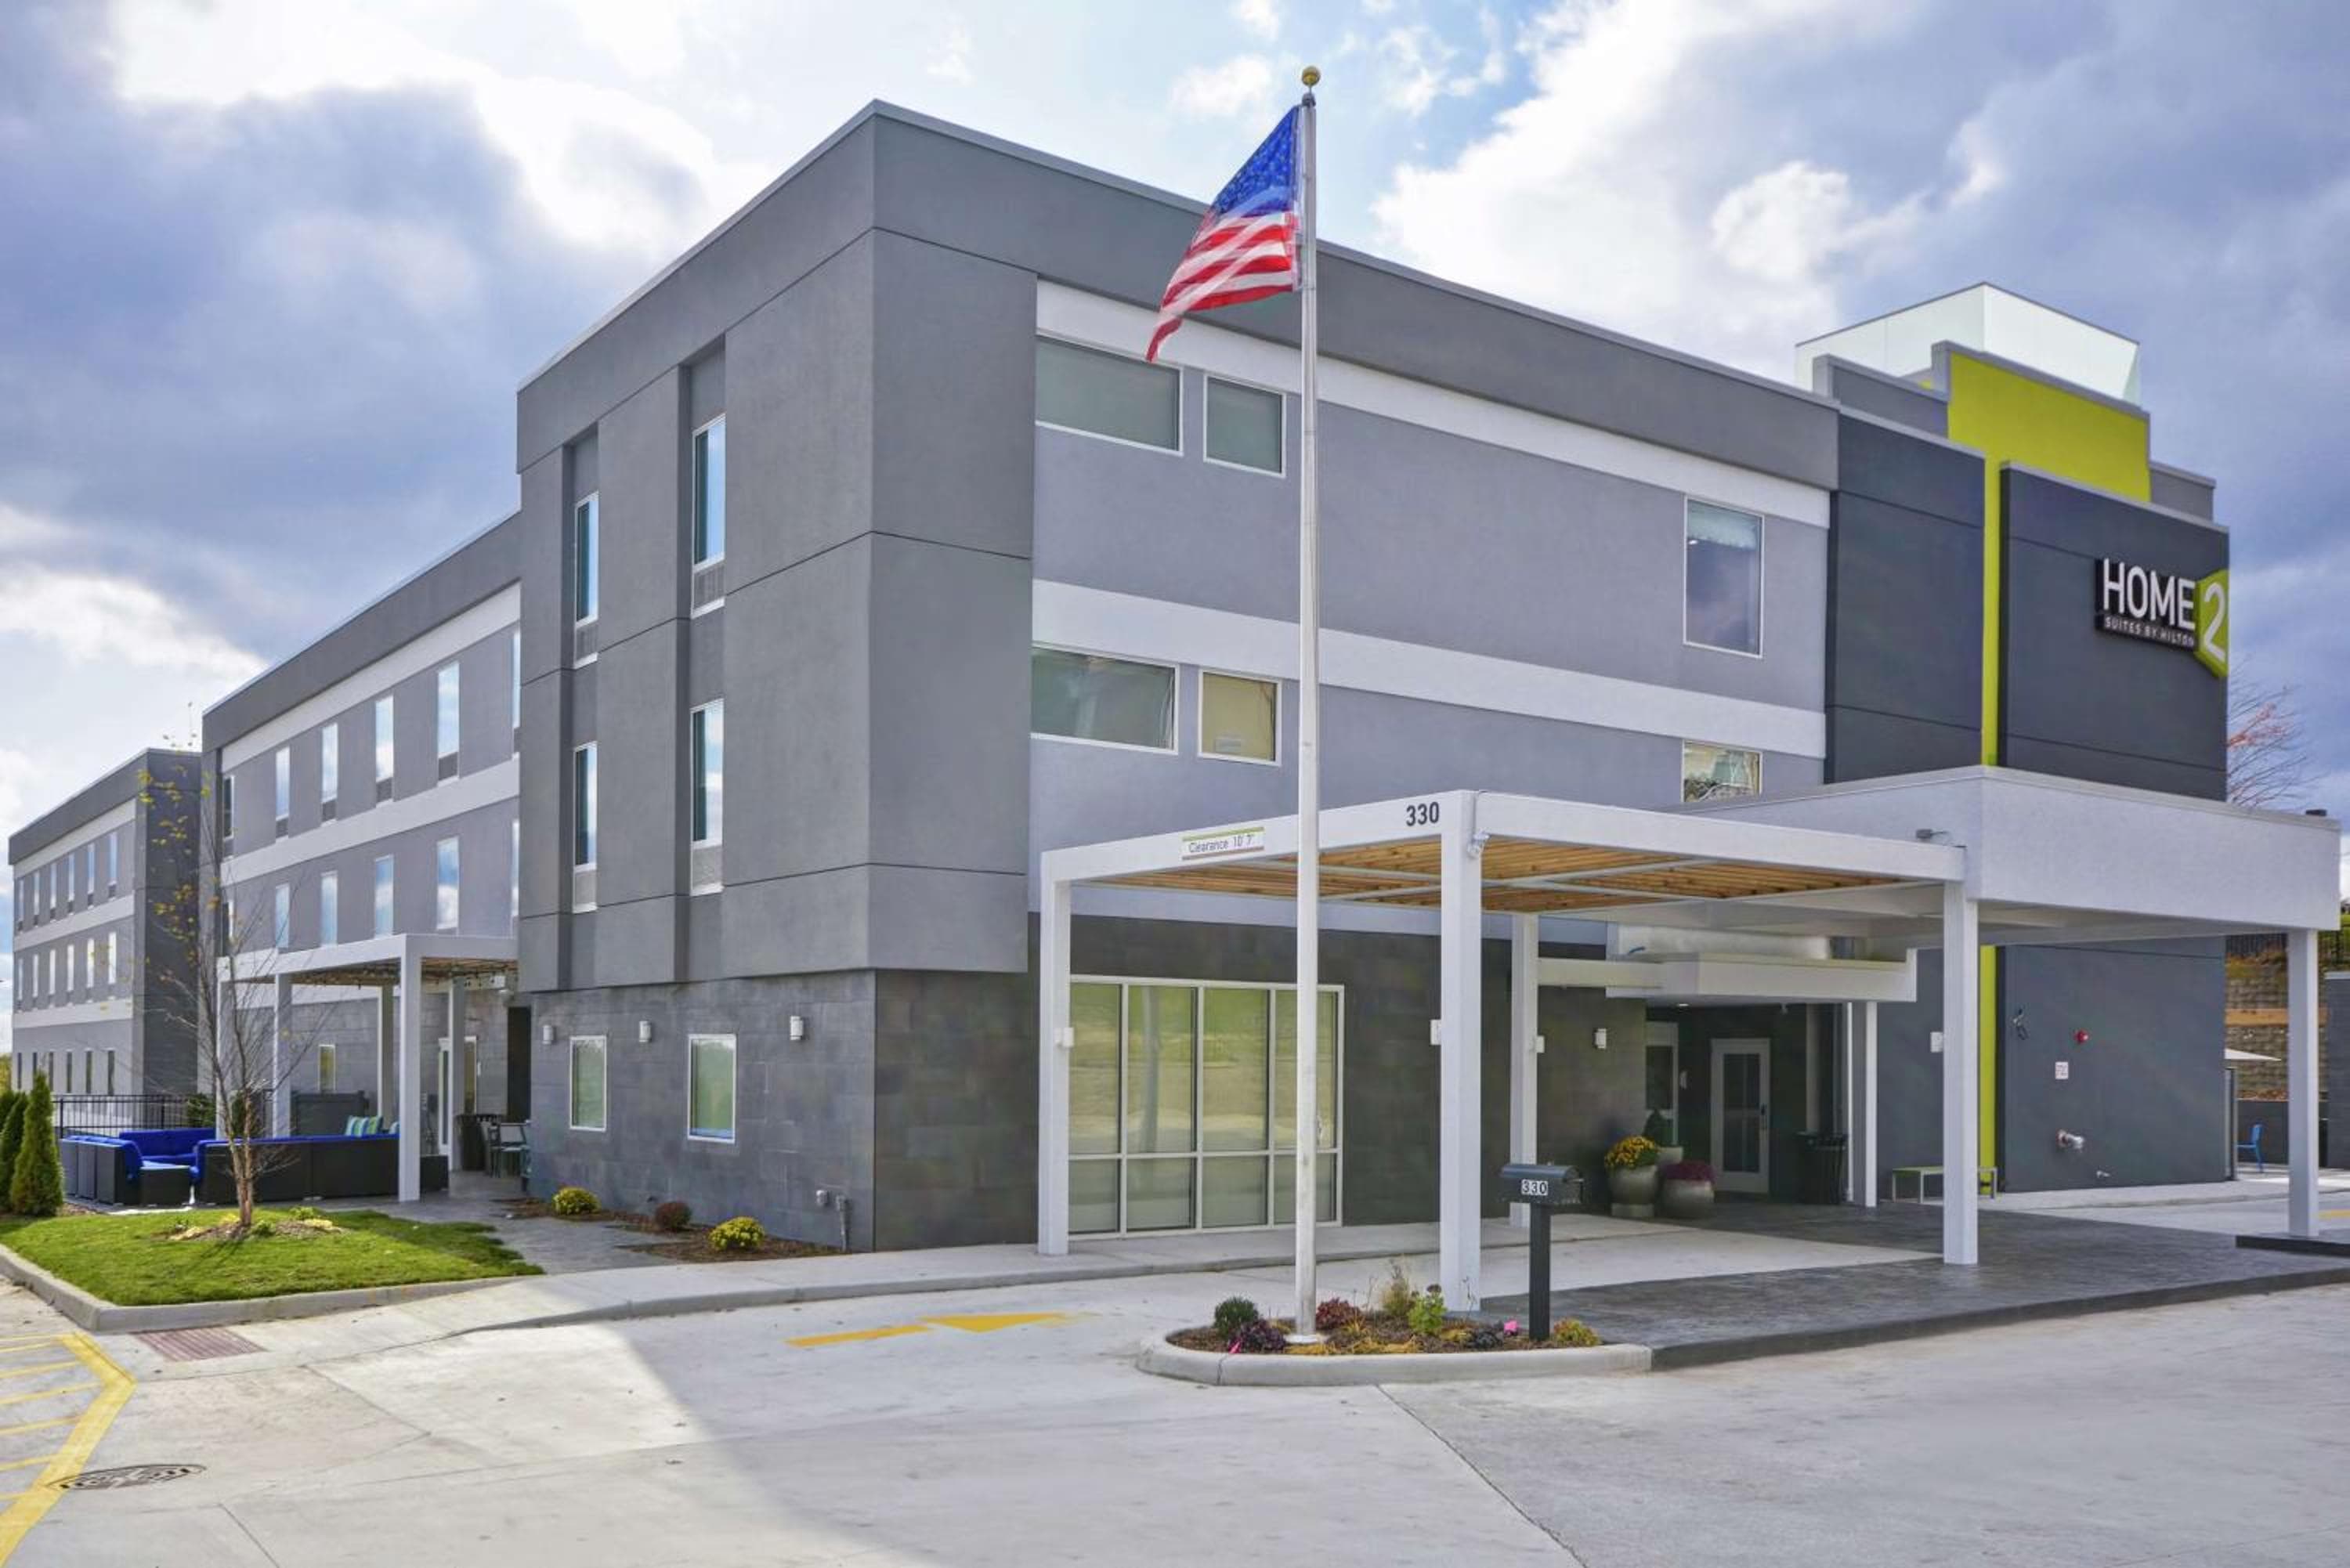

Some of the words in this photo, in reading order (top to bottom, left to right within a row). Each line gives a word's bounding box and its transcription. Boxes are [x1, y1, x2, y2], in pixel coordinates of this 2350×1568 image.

[2103, 558, 2195, 630] HOME
[2105, 616, 2141, 634] SUITES
[2145, 625, 2157, 637] BY
[2160, 629, 2194, 647] HILTON
[1406, 801, 1439, 826] 330
[1189, 839, 1228, 853] Clearance
[1521, 1180, 1548, 1195] 330
